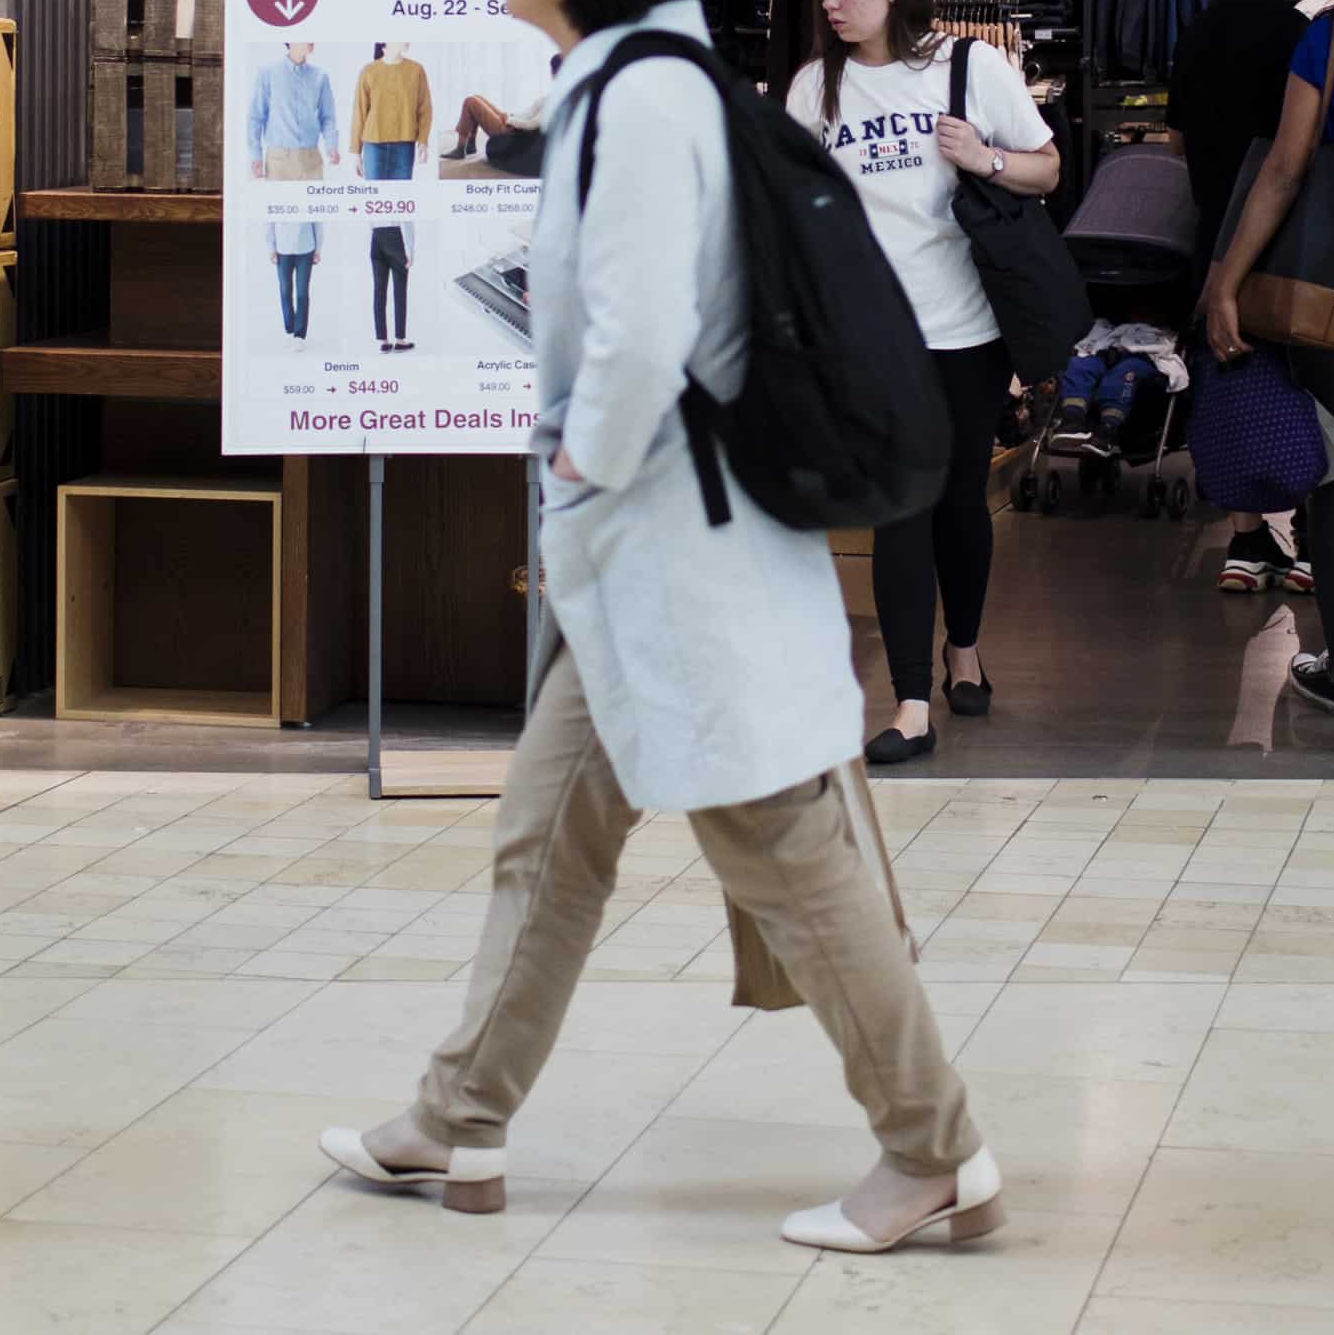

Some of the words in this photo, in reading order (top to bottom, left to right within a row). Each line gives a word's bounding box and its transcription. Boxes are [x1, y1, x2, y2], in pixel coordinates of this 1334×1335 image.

[392, 0, 437, 20] Aug.
[443, 0, 468, 16] 22
[487, 0, 510, 17] Se
[821, 112, 943, 153] CANCU
[861, 156, 923, 174] MEXICO
[307, 186, 344, 195] Oxford
[347, 185, 379, 195] Shirts
[466, 184, 493, 196] Body
[497, 184, 511, 194] Fit
[513, 184, 542, 194] Cush
[267, 205, 299, 214] $35.00
[364, 200, 415, 214] $29.90
[324, 362, 360, 372] Denim
[477, 360, 512, 370] Acrylic
[515, 360, 537, 370] Cas
[348, 380, 399, 394] $44.90
[289, 410, 352, 430] More
[359, 409, 426, 430] Great
[434, 408, 503, 429] Deals
[511, 408, 540, 428] Ins
